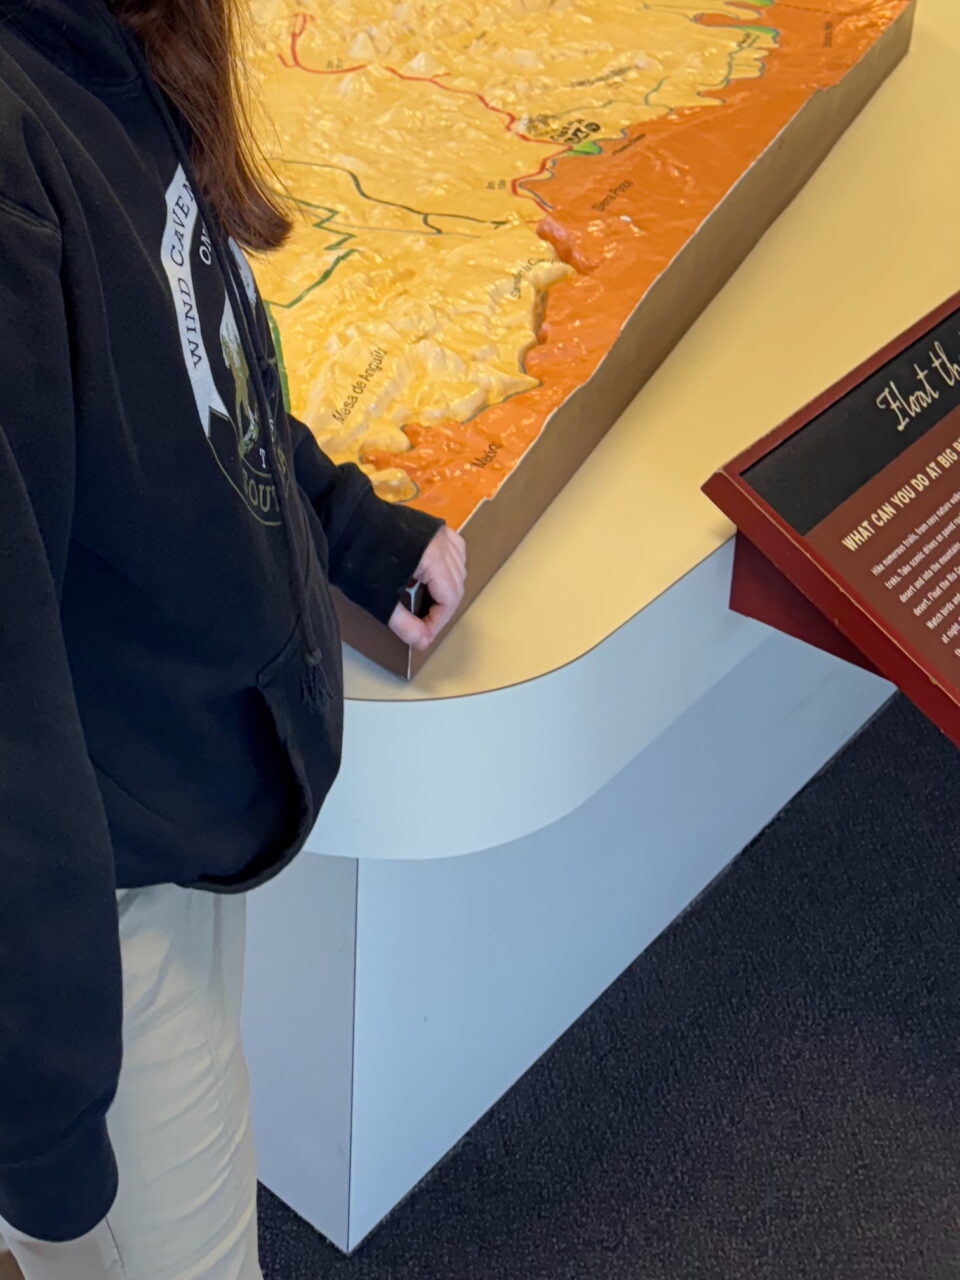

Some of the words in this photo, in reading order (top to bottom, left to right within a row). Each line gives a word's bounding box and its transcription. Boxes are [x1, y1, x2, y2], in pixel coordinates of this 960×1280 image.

[178, 277, 202, 369] WIND
[331, 393, 358, 425] Mesa
[352, 379, 367, 396] de
[876, 363, 939, 432] Float
[841, 520, 875, 551] WHAT
[870, 502, 897, 527] CAN
[890, 485, 916, 508] YOU
[910, 473, 930, 492] DO
[925, 461, 942, 480] AT
[936, 448, 958, 468] BIG
[870, 561, 885, 576] Hike
[881, 542, 906, 566] numerous
[901, 529, 920, 548] trails,
[914, 520, 929, 535] from
[925, 512, 940, 527] easy
[934, 500, 952, 517] nature
[935, 533, 944, 542] on
[939, 520, 957, 538] paved
[907, 549, 926, 567] scenic
[921, 537, 938, 554] drives
[883, 571, 902, 589] treks.
[896, 562, 912, 577] Take
[897, 584, 917, 603] desert
[912, 575, 925, 589] and
[920, 567, 934, 581] into
[929, 560, 941, 572] the
[911, 595, 932, 616] desert.
[926, 584, 943, 602] Float
[938, 577, 950, 590] the
[945, 570, 958, 582] Rio
[925, 611, 944, 630] Watch
[938, 600, 955, 616] birds
[941, 634, 950, 644] at
